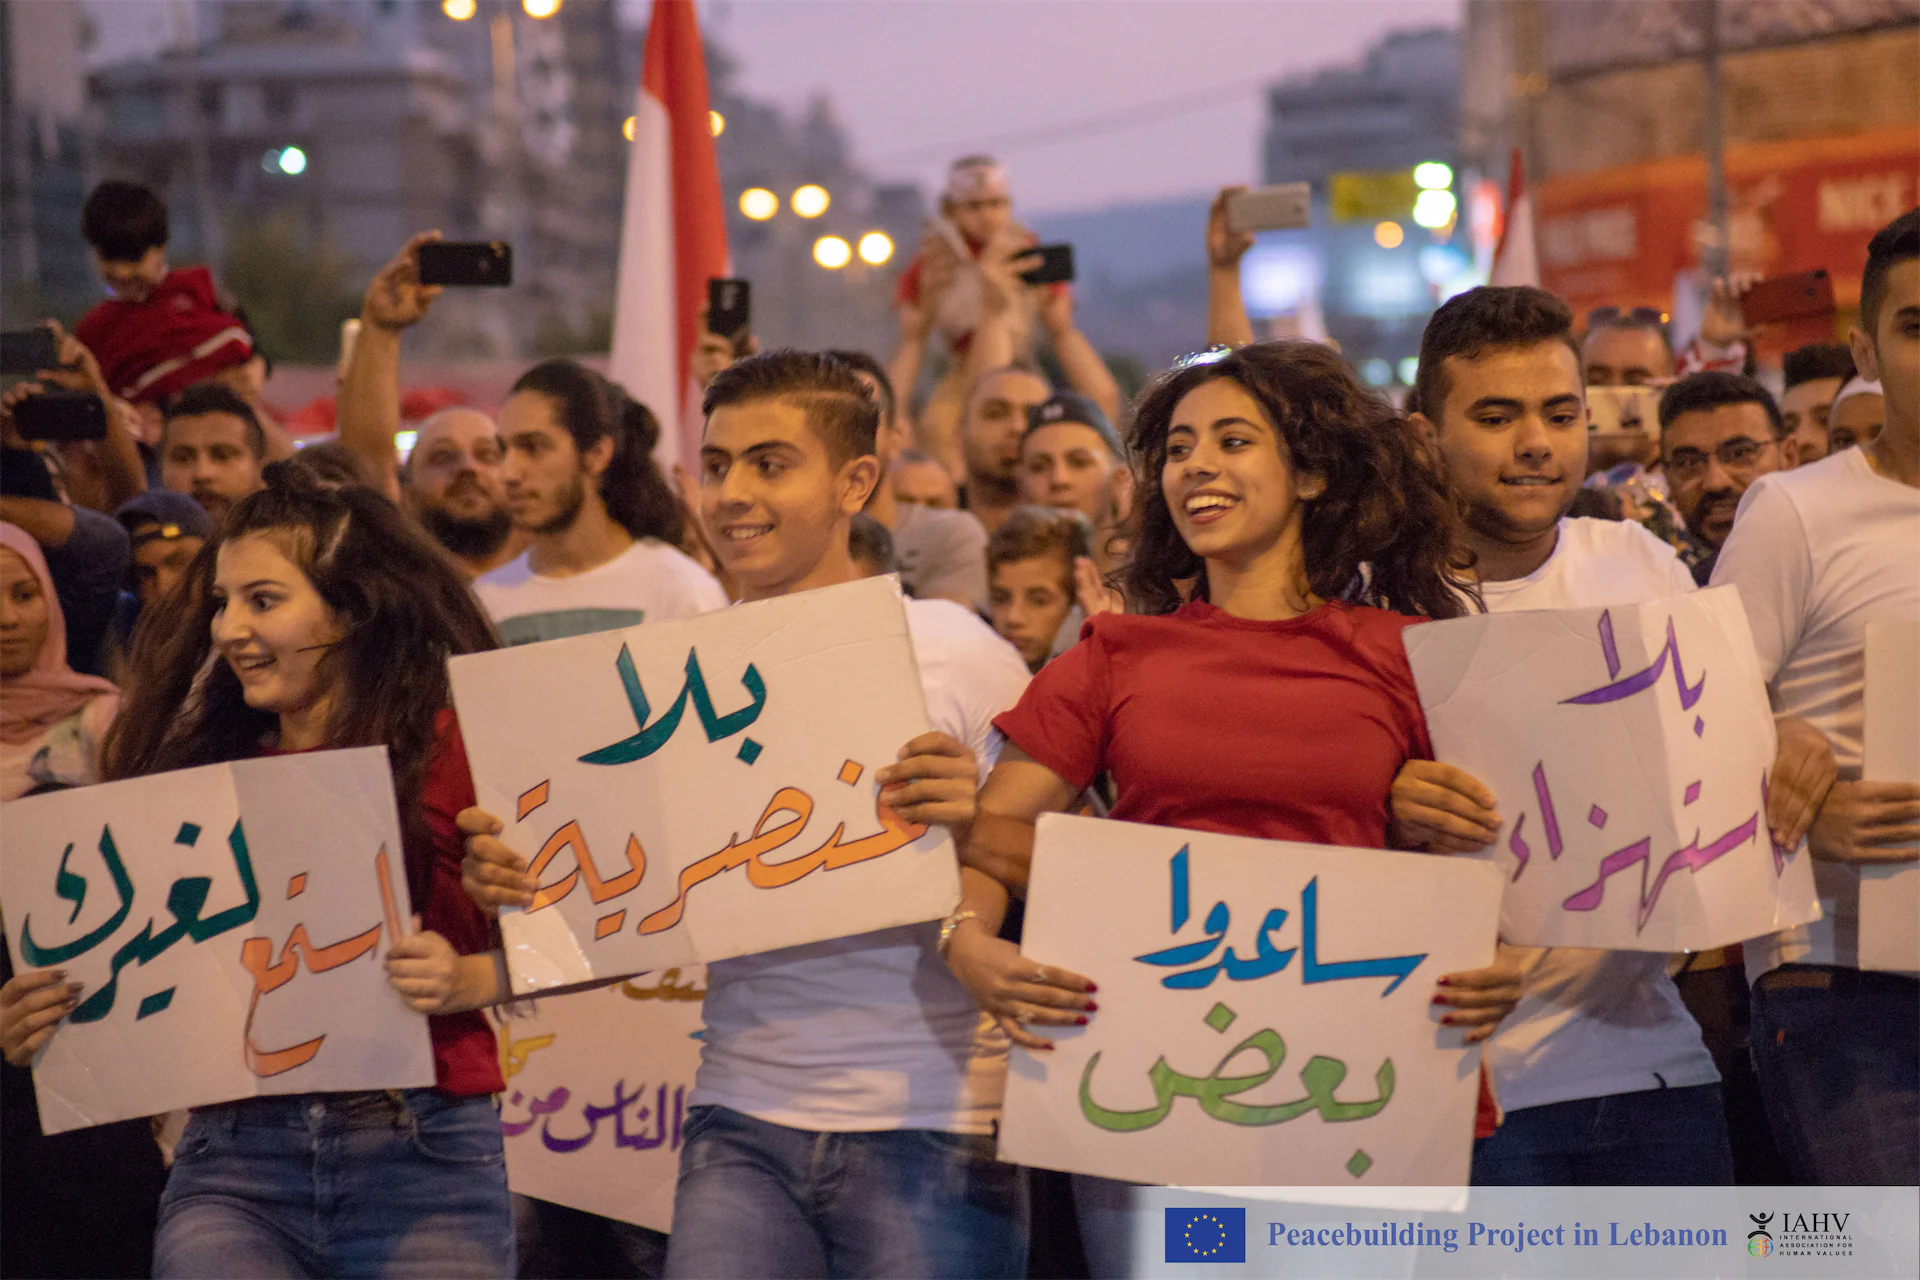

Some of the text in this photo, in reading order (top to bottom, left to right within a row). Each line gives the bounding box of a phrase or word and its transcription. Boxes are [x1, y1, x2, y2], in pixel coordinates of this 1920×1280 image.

[578, 642, 767, 766] بلا
[1556, 608, 1707, 738] بلا
[19, 817, 261, 1024] لغيرك
[1132, 842, 1429, 999] ساعدوا
[540, 1077, 685, 1154] الناس
[1077, 1001, 1396, 1180] بعض
